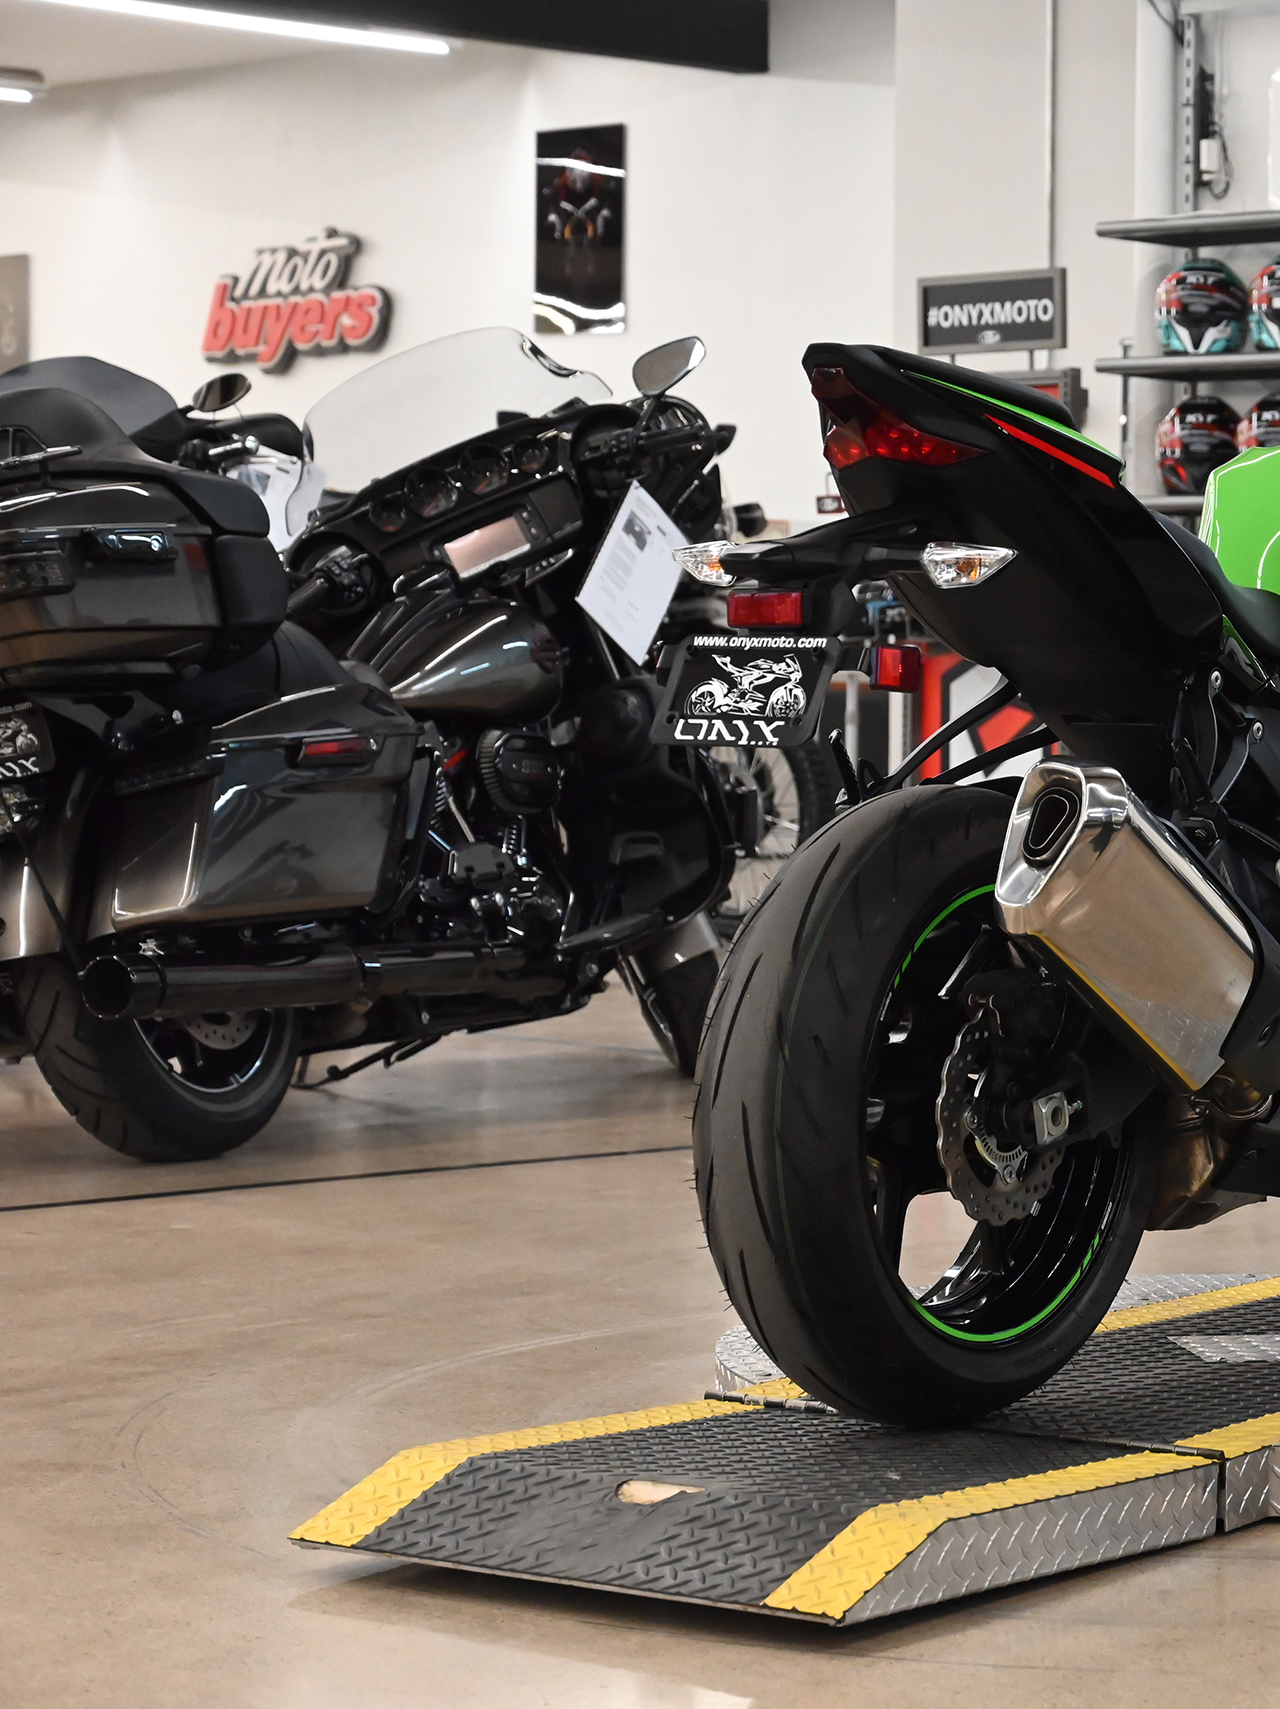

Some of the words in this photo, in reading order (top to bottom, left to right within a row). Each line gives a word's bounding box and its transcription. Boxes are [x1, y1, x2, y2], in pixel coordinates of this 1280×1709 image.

[202, 278, 380, 366] buyers
[927, 298, 1054, 329] #ONYXMOTO
[693, 636, 828, 650] www.onyxmoto.com
